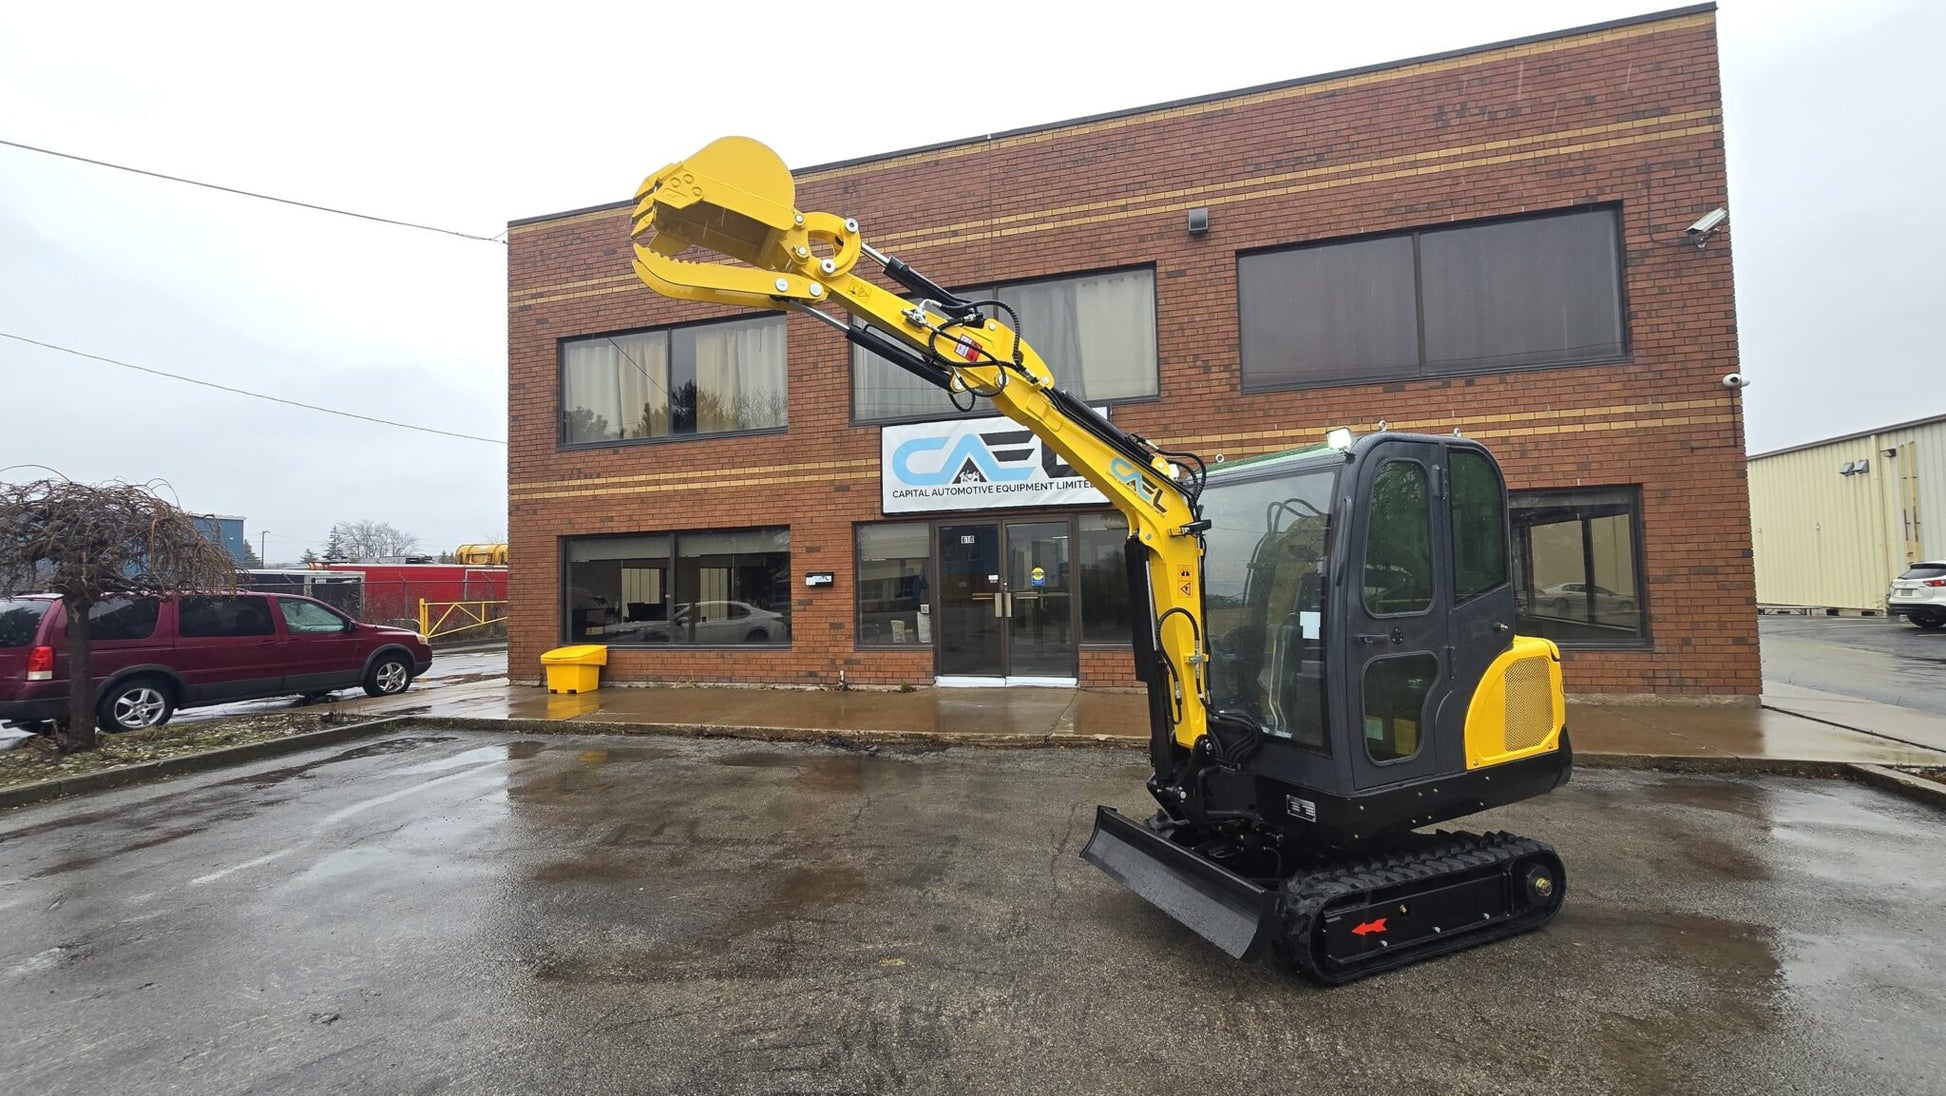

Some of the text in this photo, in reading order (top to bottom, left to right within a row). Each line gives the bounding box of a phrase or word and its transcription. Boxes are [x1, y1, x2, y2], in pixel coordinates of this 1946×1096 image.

[892, 488, 930, 498] CAPITAL
[931, 485, 993, 497] AUTOMOTIVE
[996, 482, 1054, 493] EQUIPMENT
